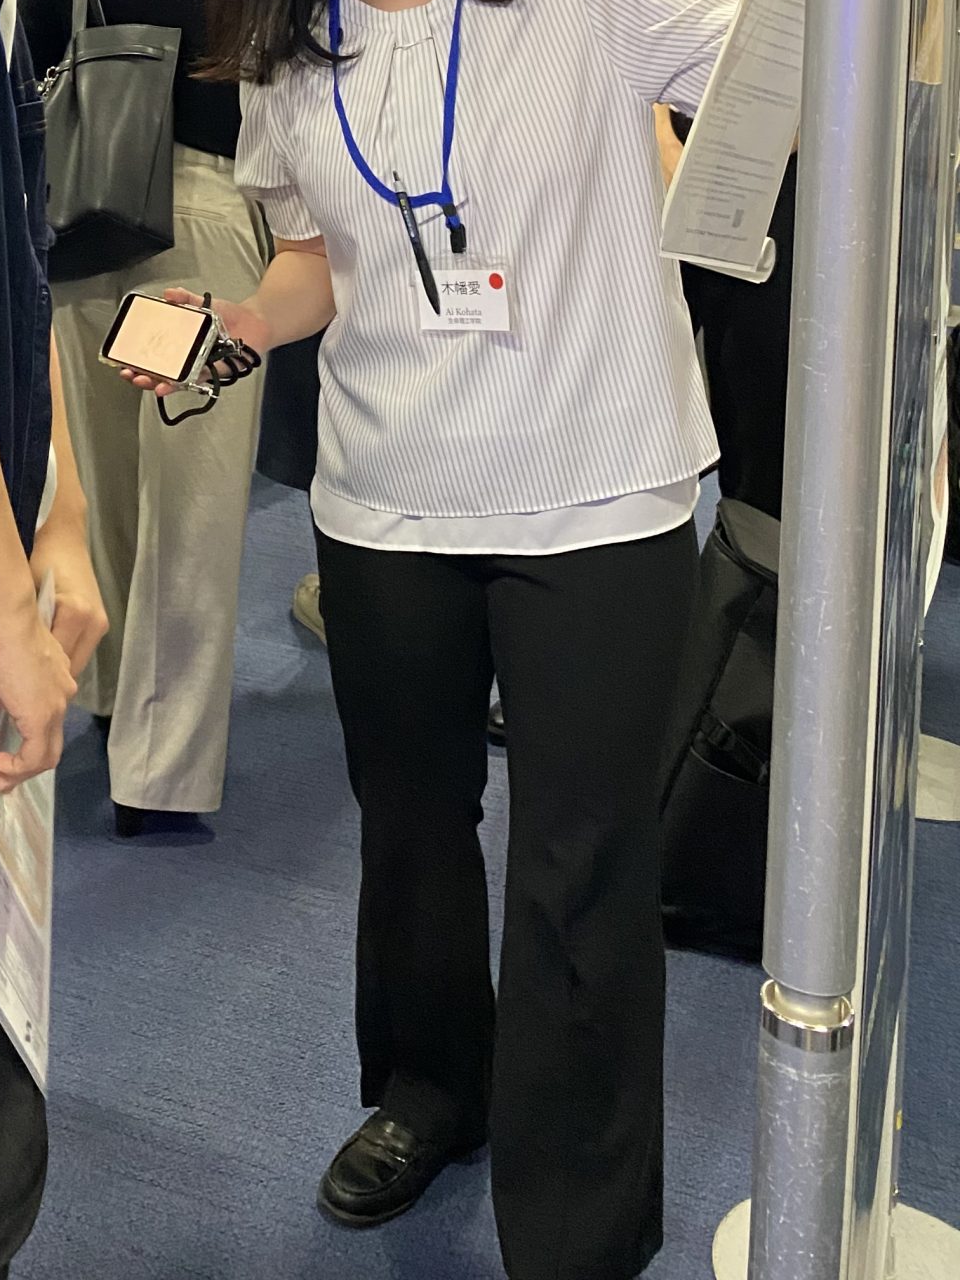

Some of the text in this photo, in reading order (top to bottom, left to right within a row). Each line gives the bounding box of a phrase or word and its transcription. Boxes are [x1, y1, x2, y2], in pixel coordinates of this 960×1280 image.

[441, 281, 481, 295] 木幡愛
[446, 308, 454, 316] Ai
